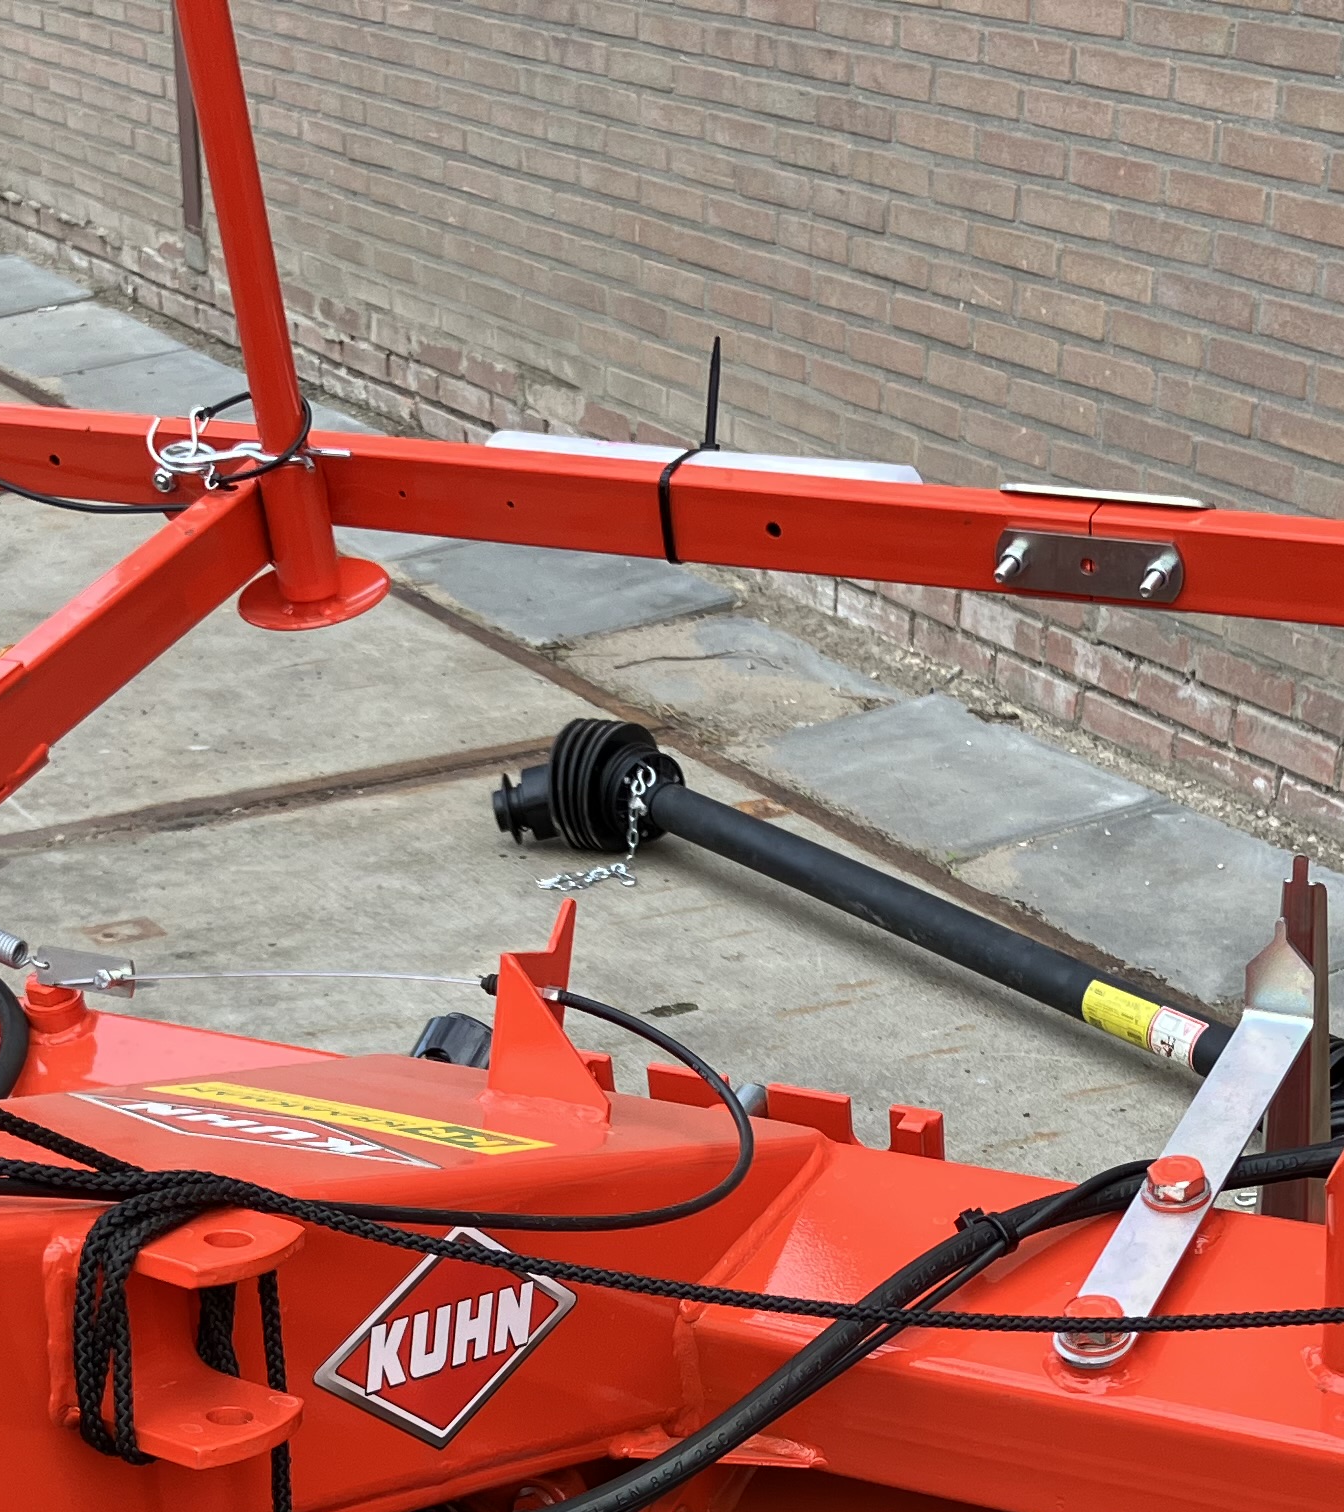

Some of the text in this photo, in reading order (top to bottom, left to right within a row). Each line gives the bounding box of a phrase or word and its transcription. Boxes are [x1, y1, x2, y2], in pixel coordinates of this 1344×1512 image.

[128, 1101, 380, 1154] KUHN
[414, 1126, 512, 1148] KR
[365, 1280, 534, 1396] KUHN
[615, 1486, 640, 1506] EN
[649, 1460, 684, 1489] 857
